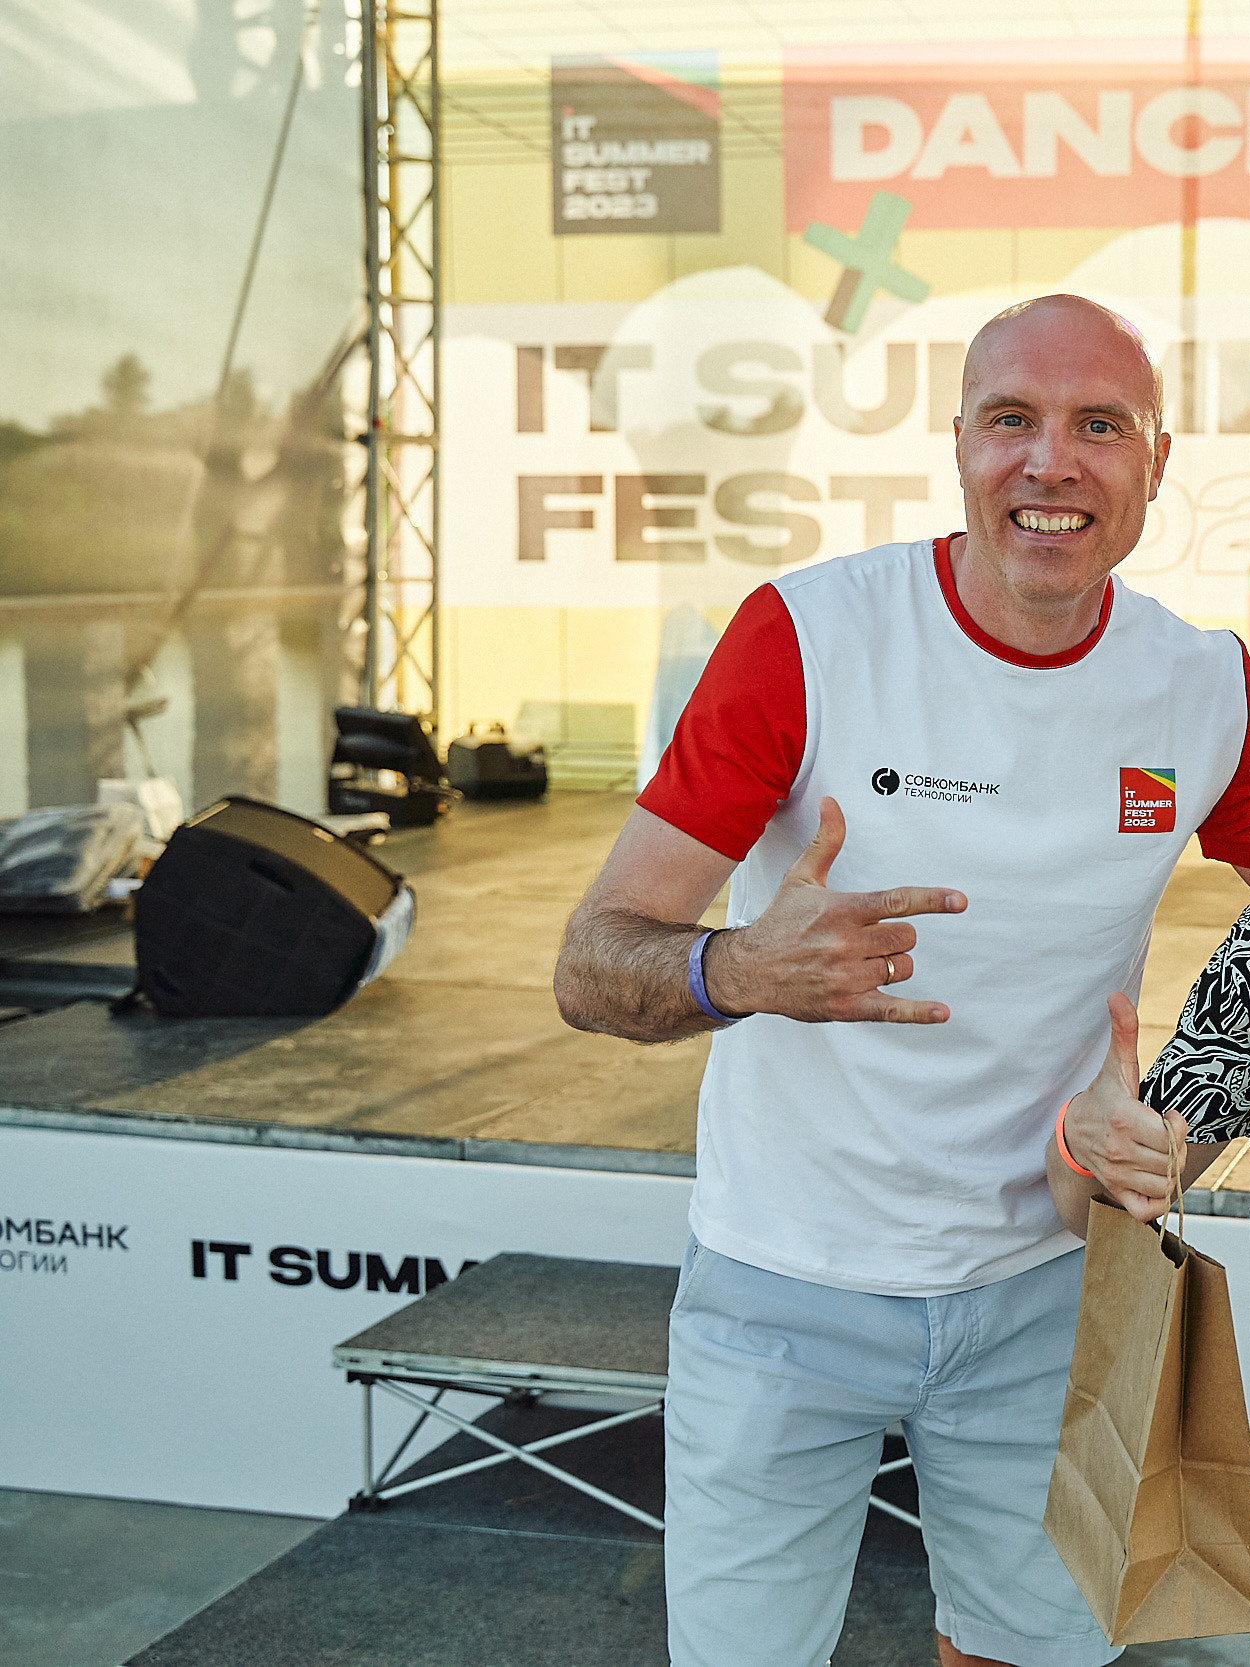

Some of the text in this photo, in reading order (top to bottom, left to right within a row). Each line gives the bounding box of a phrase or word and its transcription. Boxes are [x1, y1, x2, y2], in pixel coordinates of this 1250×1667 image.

[561, 139, 711, 167] SUMMER
[561, 166, 653, 194] FEST
[562, 193, 659, 220] 2023
[516, 342, 653, 434] IT
[517, 471, 929, 567] FEST
[904, 774, 1001, 795] СОВКОМБАНК
[904, 787, 972, 803] ТЕХНОЛОГИИ
[1124, 809, 1155, 817] FEST
[1125, 799, 1172, 808] SUMMER
[1124, 818, 1156, 827] 2023
[0, 1216, 129, 1251] МБАНК
[191, 1240, 252, 1280] IT
